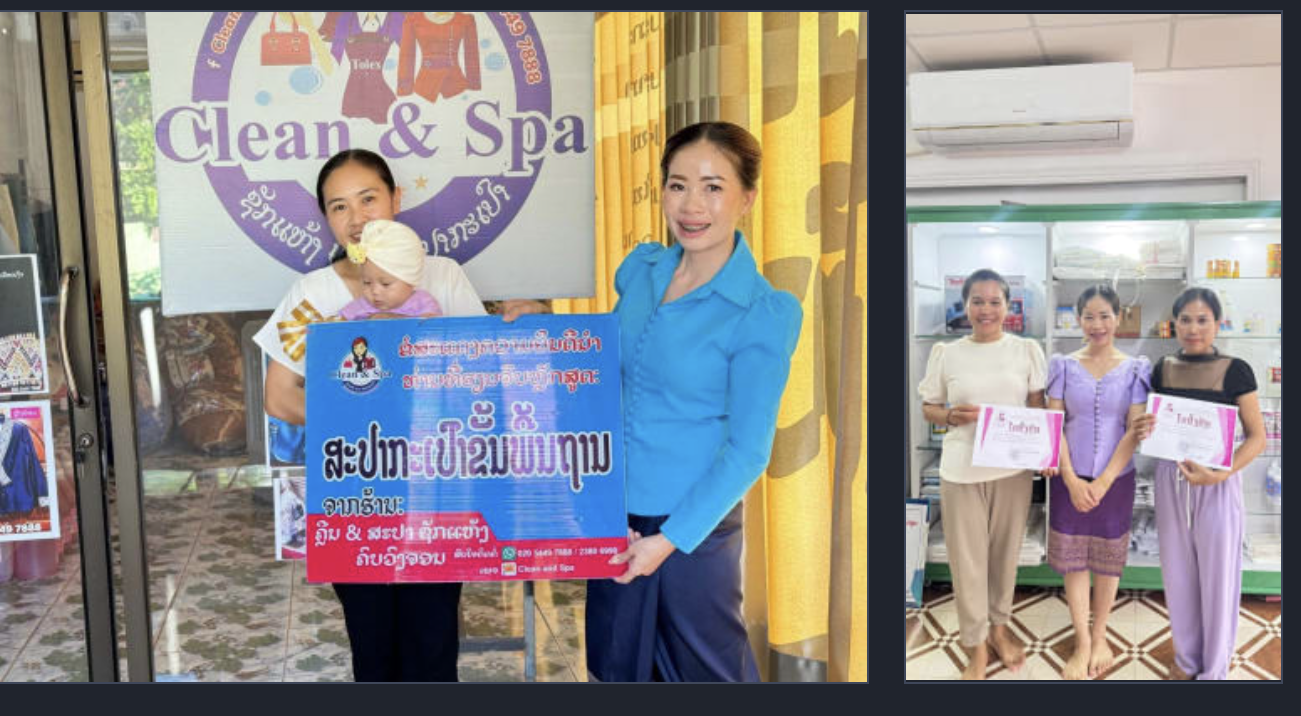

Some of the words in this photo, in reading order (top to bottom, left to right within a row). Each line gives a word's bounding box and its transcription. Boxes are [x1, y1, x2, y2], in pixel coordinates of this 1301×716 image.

[516, 35, 542, 84] 7888
[155, 105, 354, 163] Clean
[378, 101, 439, 159] &
[465, 99, 589, 173] Spa
[346, 524, 363, 542] &
